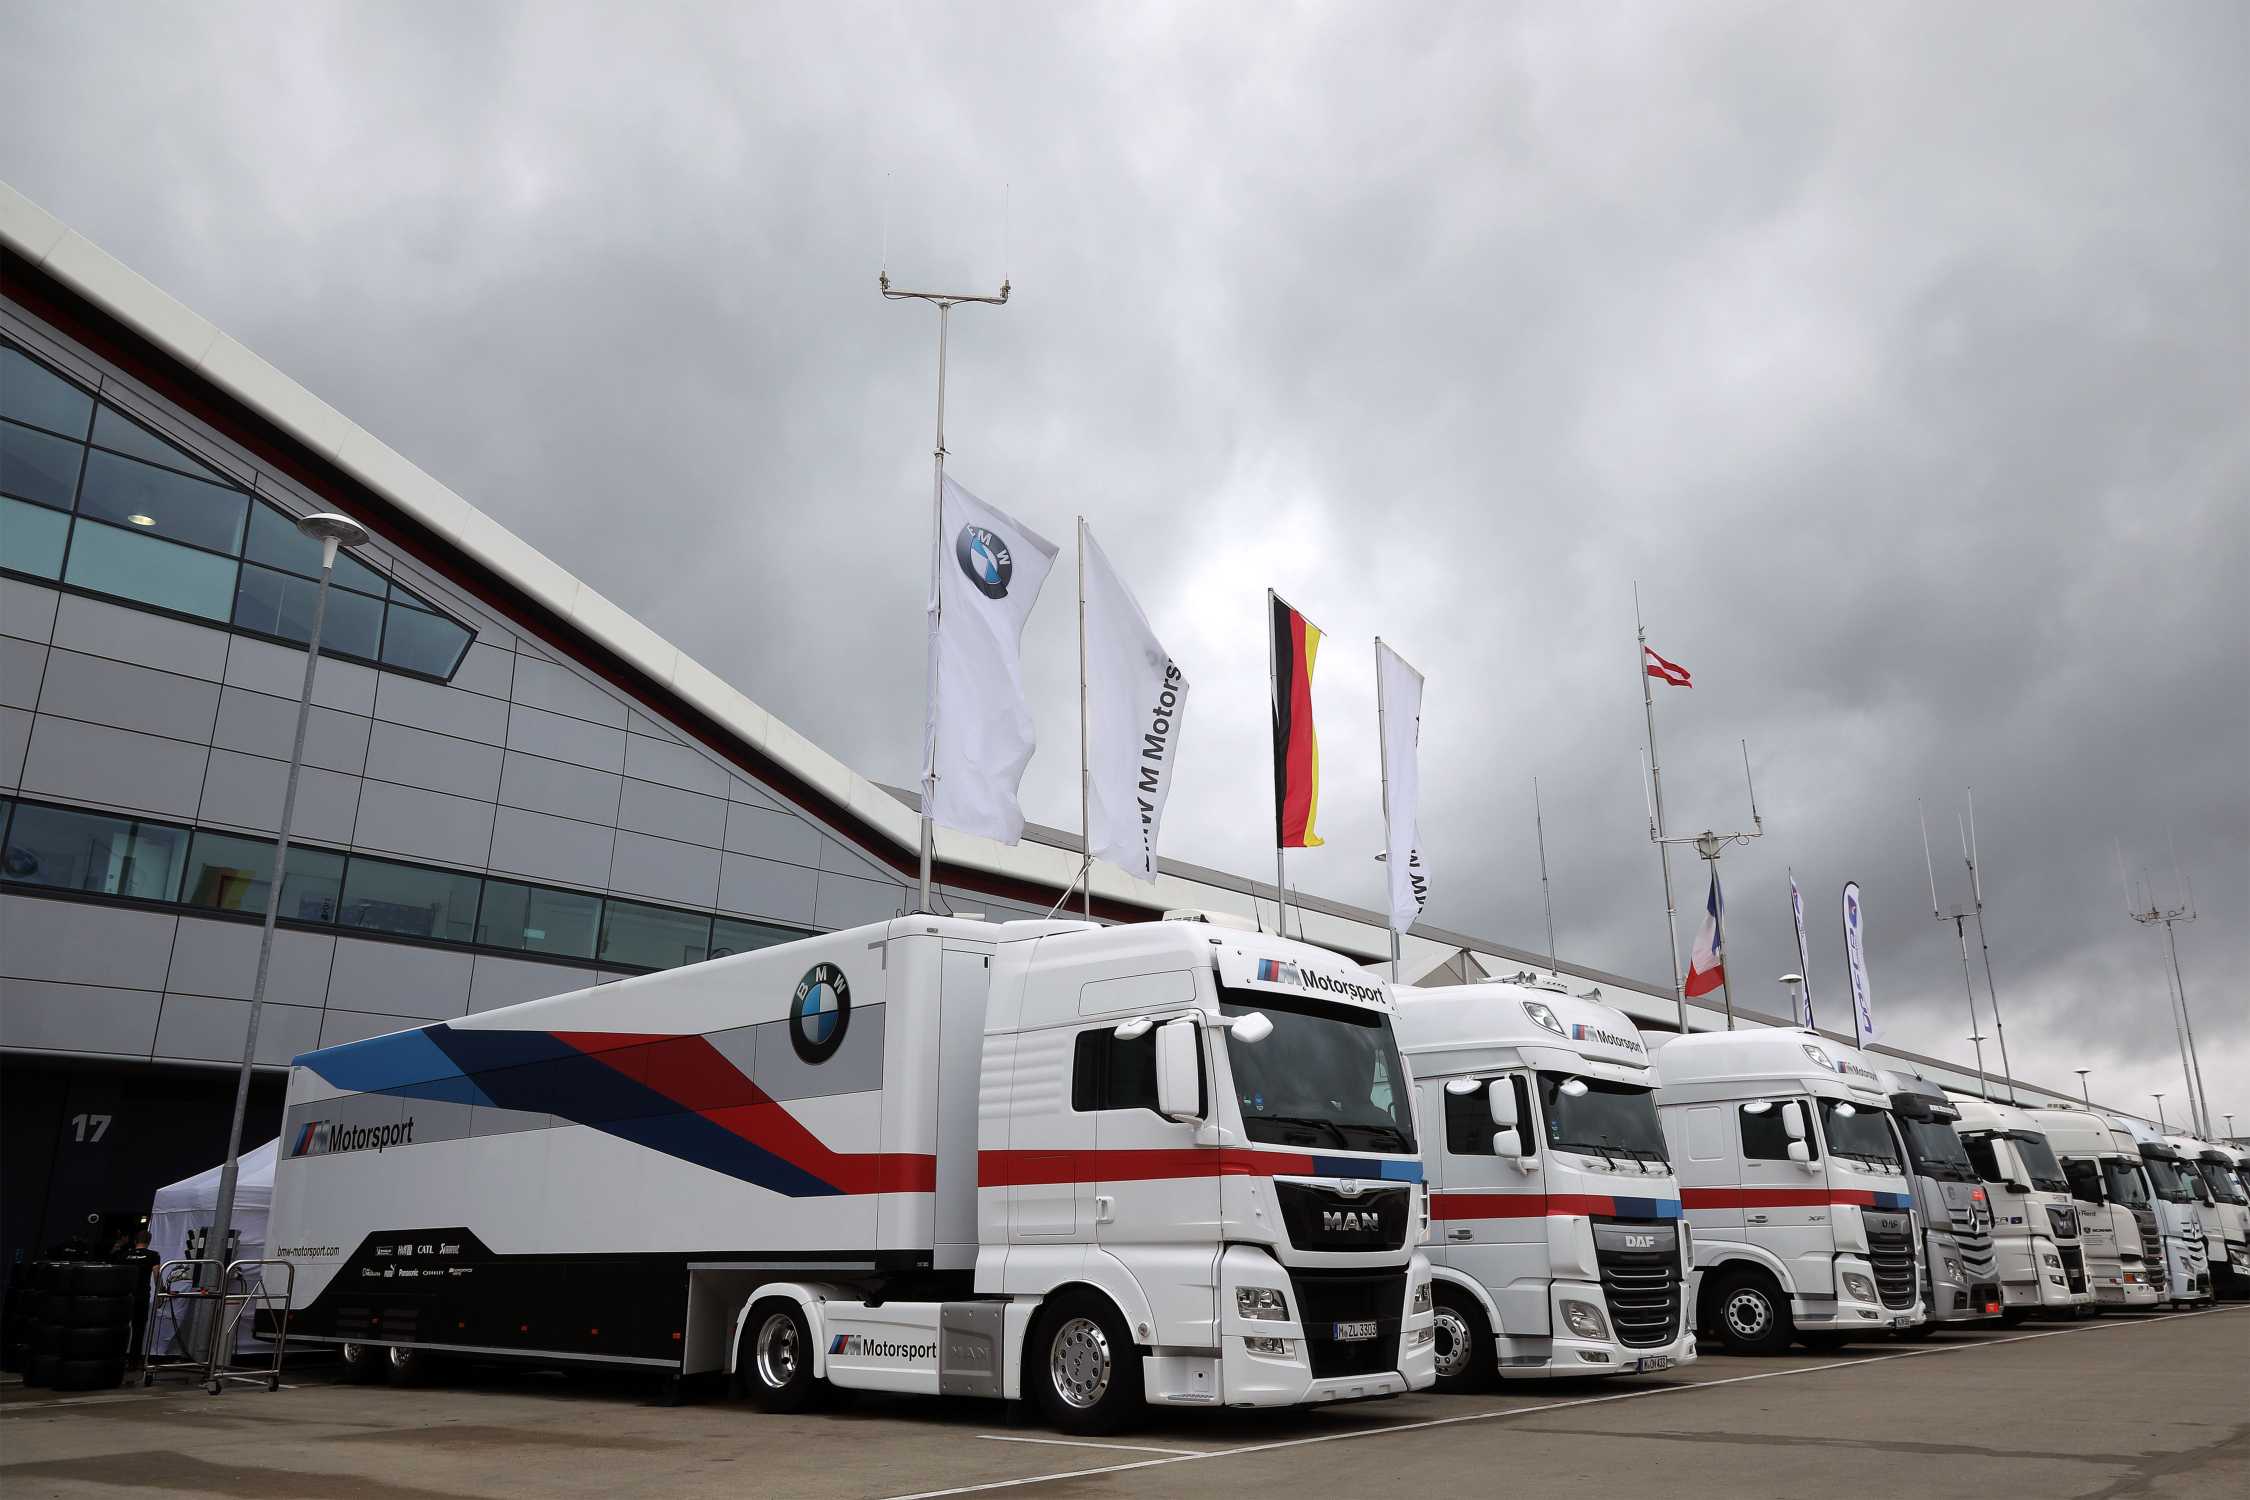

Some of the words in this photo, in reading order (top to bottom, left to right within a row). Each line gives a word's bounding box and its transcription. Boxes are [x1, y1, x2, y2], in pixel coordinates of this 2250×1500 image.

[1142, 657, 1182, 761] Motors
[1138, 765, 1160, 793] M
[1300, 968, 1386, 1004] Motorsport
[1597, 1029, 1643, 1053] Motorsport
[72, 1113, 112, 1142] 17
[328, 1116, 414, 1153] Motorsport
[1323, 1211, 1380, 1231] MAN
[277, 1244, 340, 1260] bmw-motorsport.com
[417, 1245, 434, 1254] CATL
[1625, 1235, 1655, 1248] DAF
[863, 1338, 937, 1361] Motorsport
